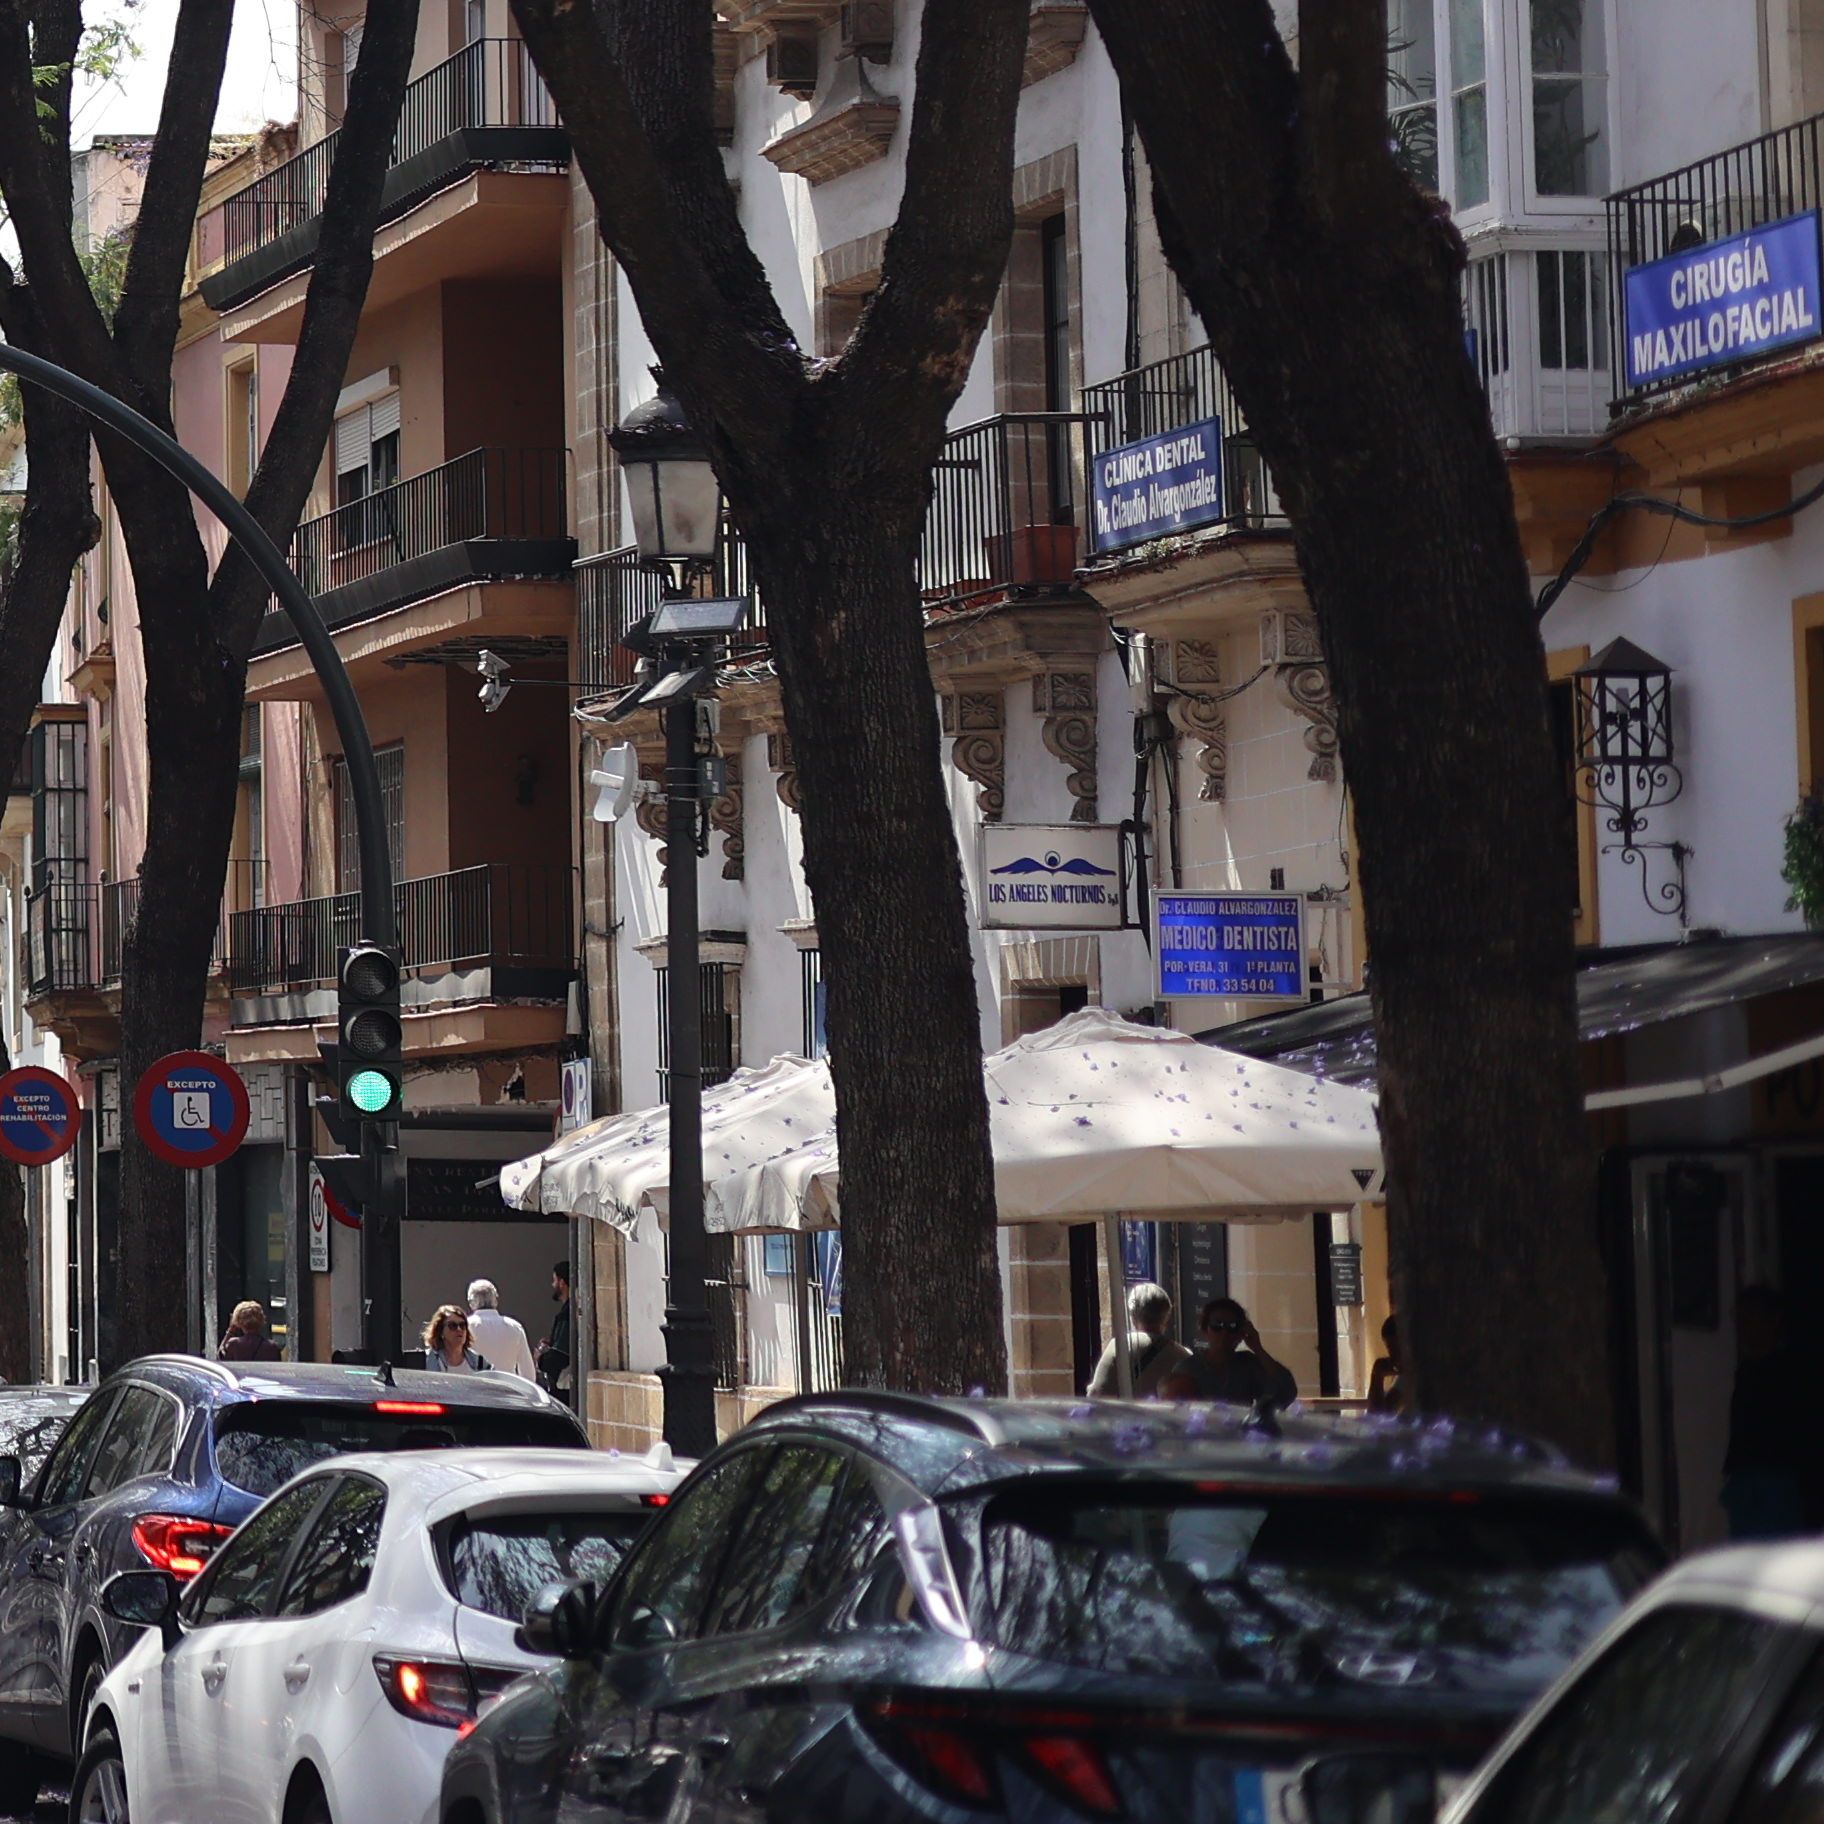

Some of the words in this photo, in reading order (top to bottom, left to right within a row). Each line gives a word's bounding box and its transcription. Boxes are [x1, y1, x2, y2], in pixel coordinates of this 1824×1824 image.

[1670, 236, 1770, 310] CIRUGÍA
[1633, 285, 1813, 375] MAXILOFACIAL
[1104, 453, 1154, 489] CLÍNICA
[1155, 433, 1206, 473] DENTAL
[1097, 499, 1111, 535] Dr.
[1111, 487, 1147, 531] Claudio
[1149, 467, 1217, 523] Alvargonzález
[988, 884, 1006, 904] LOS
[1008, 883, 1049, 904] ANGELES
[1050, 883, 1106, 905] NOCTURNOS
[1159, 902, 1172, 915] Dr.
[1174, 901, 1216, 916] CLAUDIO
[1218, 901, 1297, 916] ALVARGONZALEZ
[1160, 925, 1217, 951] MEDICO
[1223, 925, 1298, 952] DENTISTA
[1218, 961, 1229, 973] 31
[1257, 961, 1296, 974] PLANTA
[1186, 978, 1219, 992] TFNO.
[1223, 978, 1239, 992] 33
[1240, 978, 1257, 992] 54
[1258, 978, 1275, 992] 04
[167, 1080, 217, 1090] EXCEPTO
[13, 1095, 51, 1103] EXCEPTO
[16, 1105, 51, 1113] CENTRO
